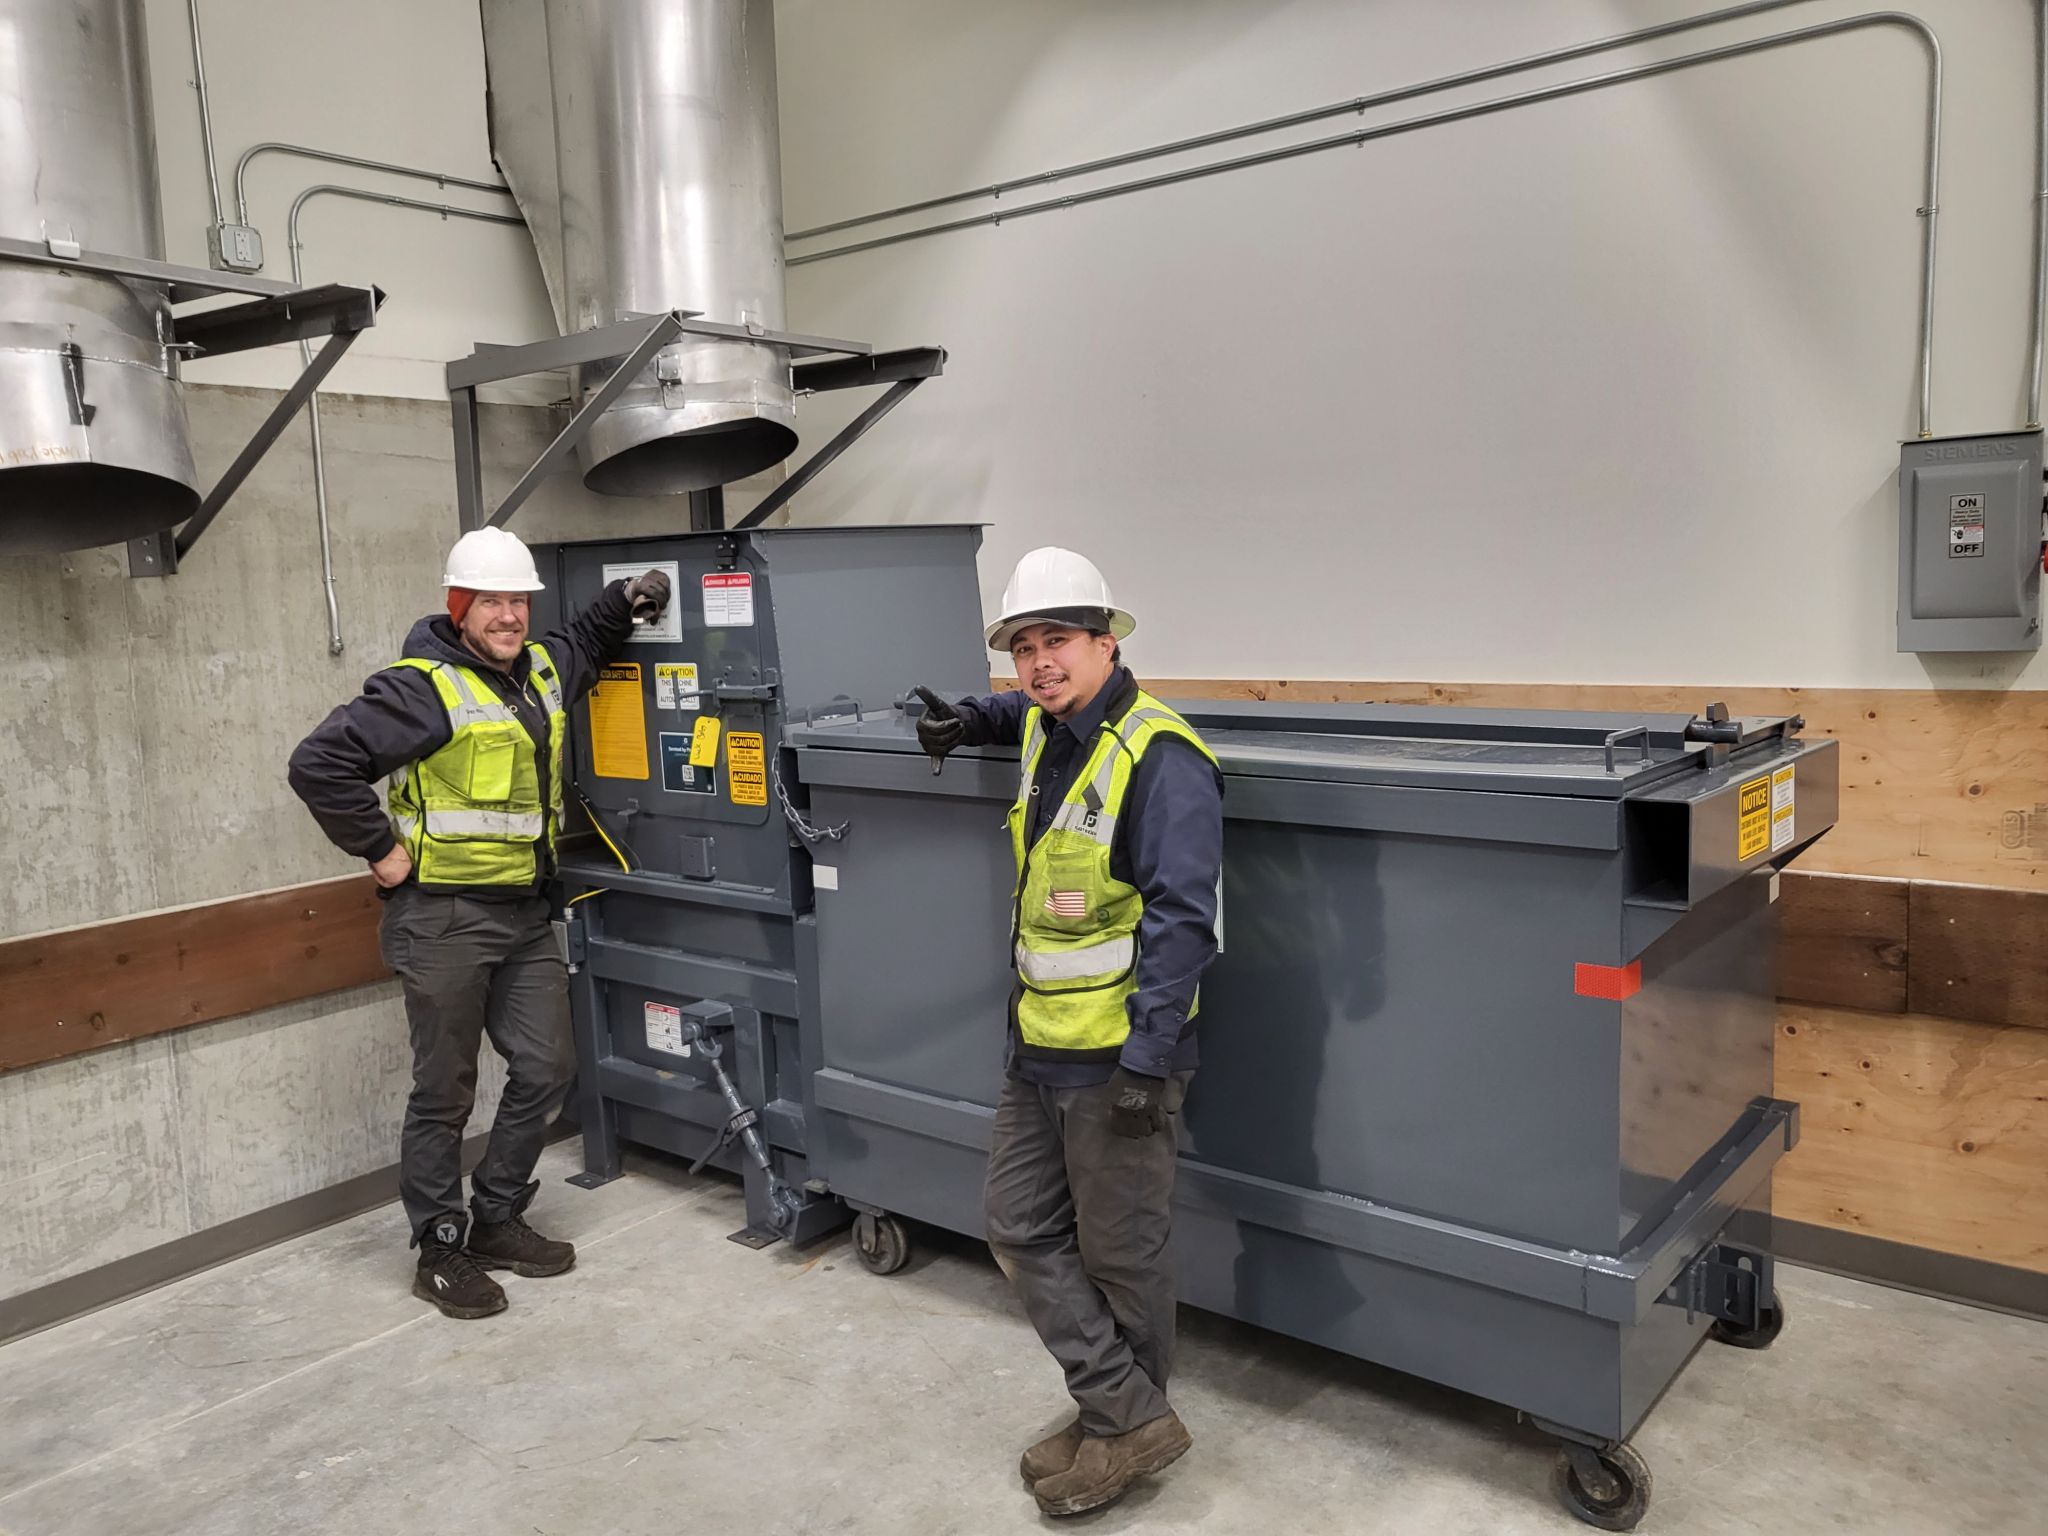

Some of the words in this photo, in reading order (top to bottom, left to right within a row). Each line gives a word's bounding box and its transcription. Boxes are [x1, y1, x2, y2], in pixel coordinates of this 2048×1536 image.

[1924, 442, 2016, 462] SIEMENS
[1958, 498, 1977, 507] ON
[1954, 544, 1979, 553] OFF
[735, 737, 759, 748] CAUTION
[737, 773, 762, 783] CUIDADO
[1743, 788, 1766, 812] NOTICE
